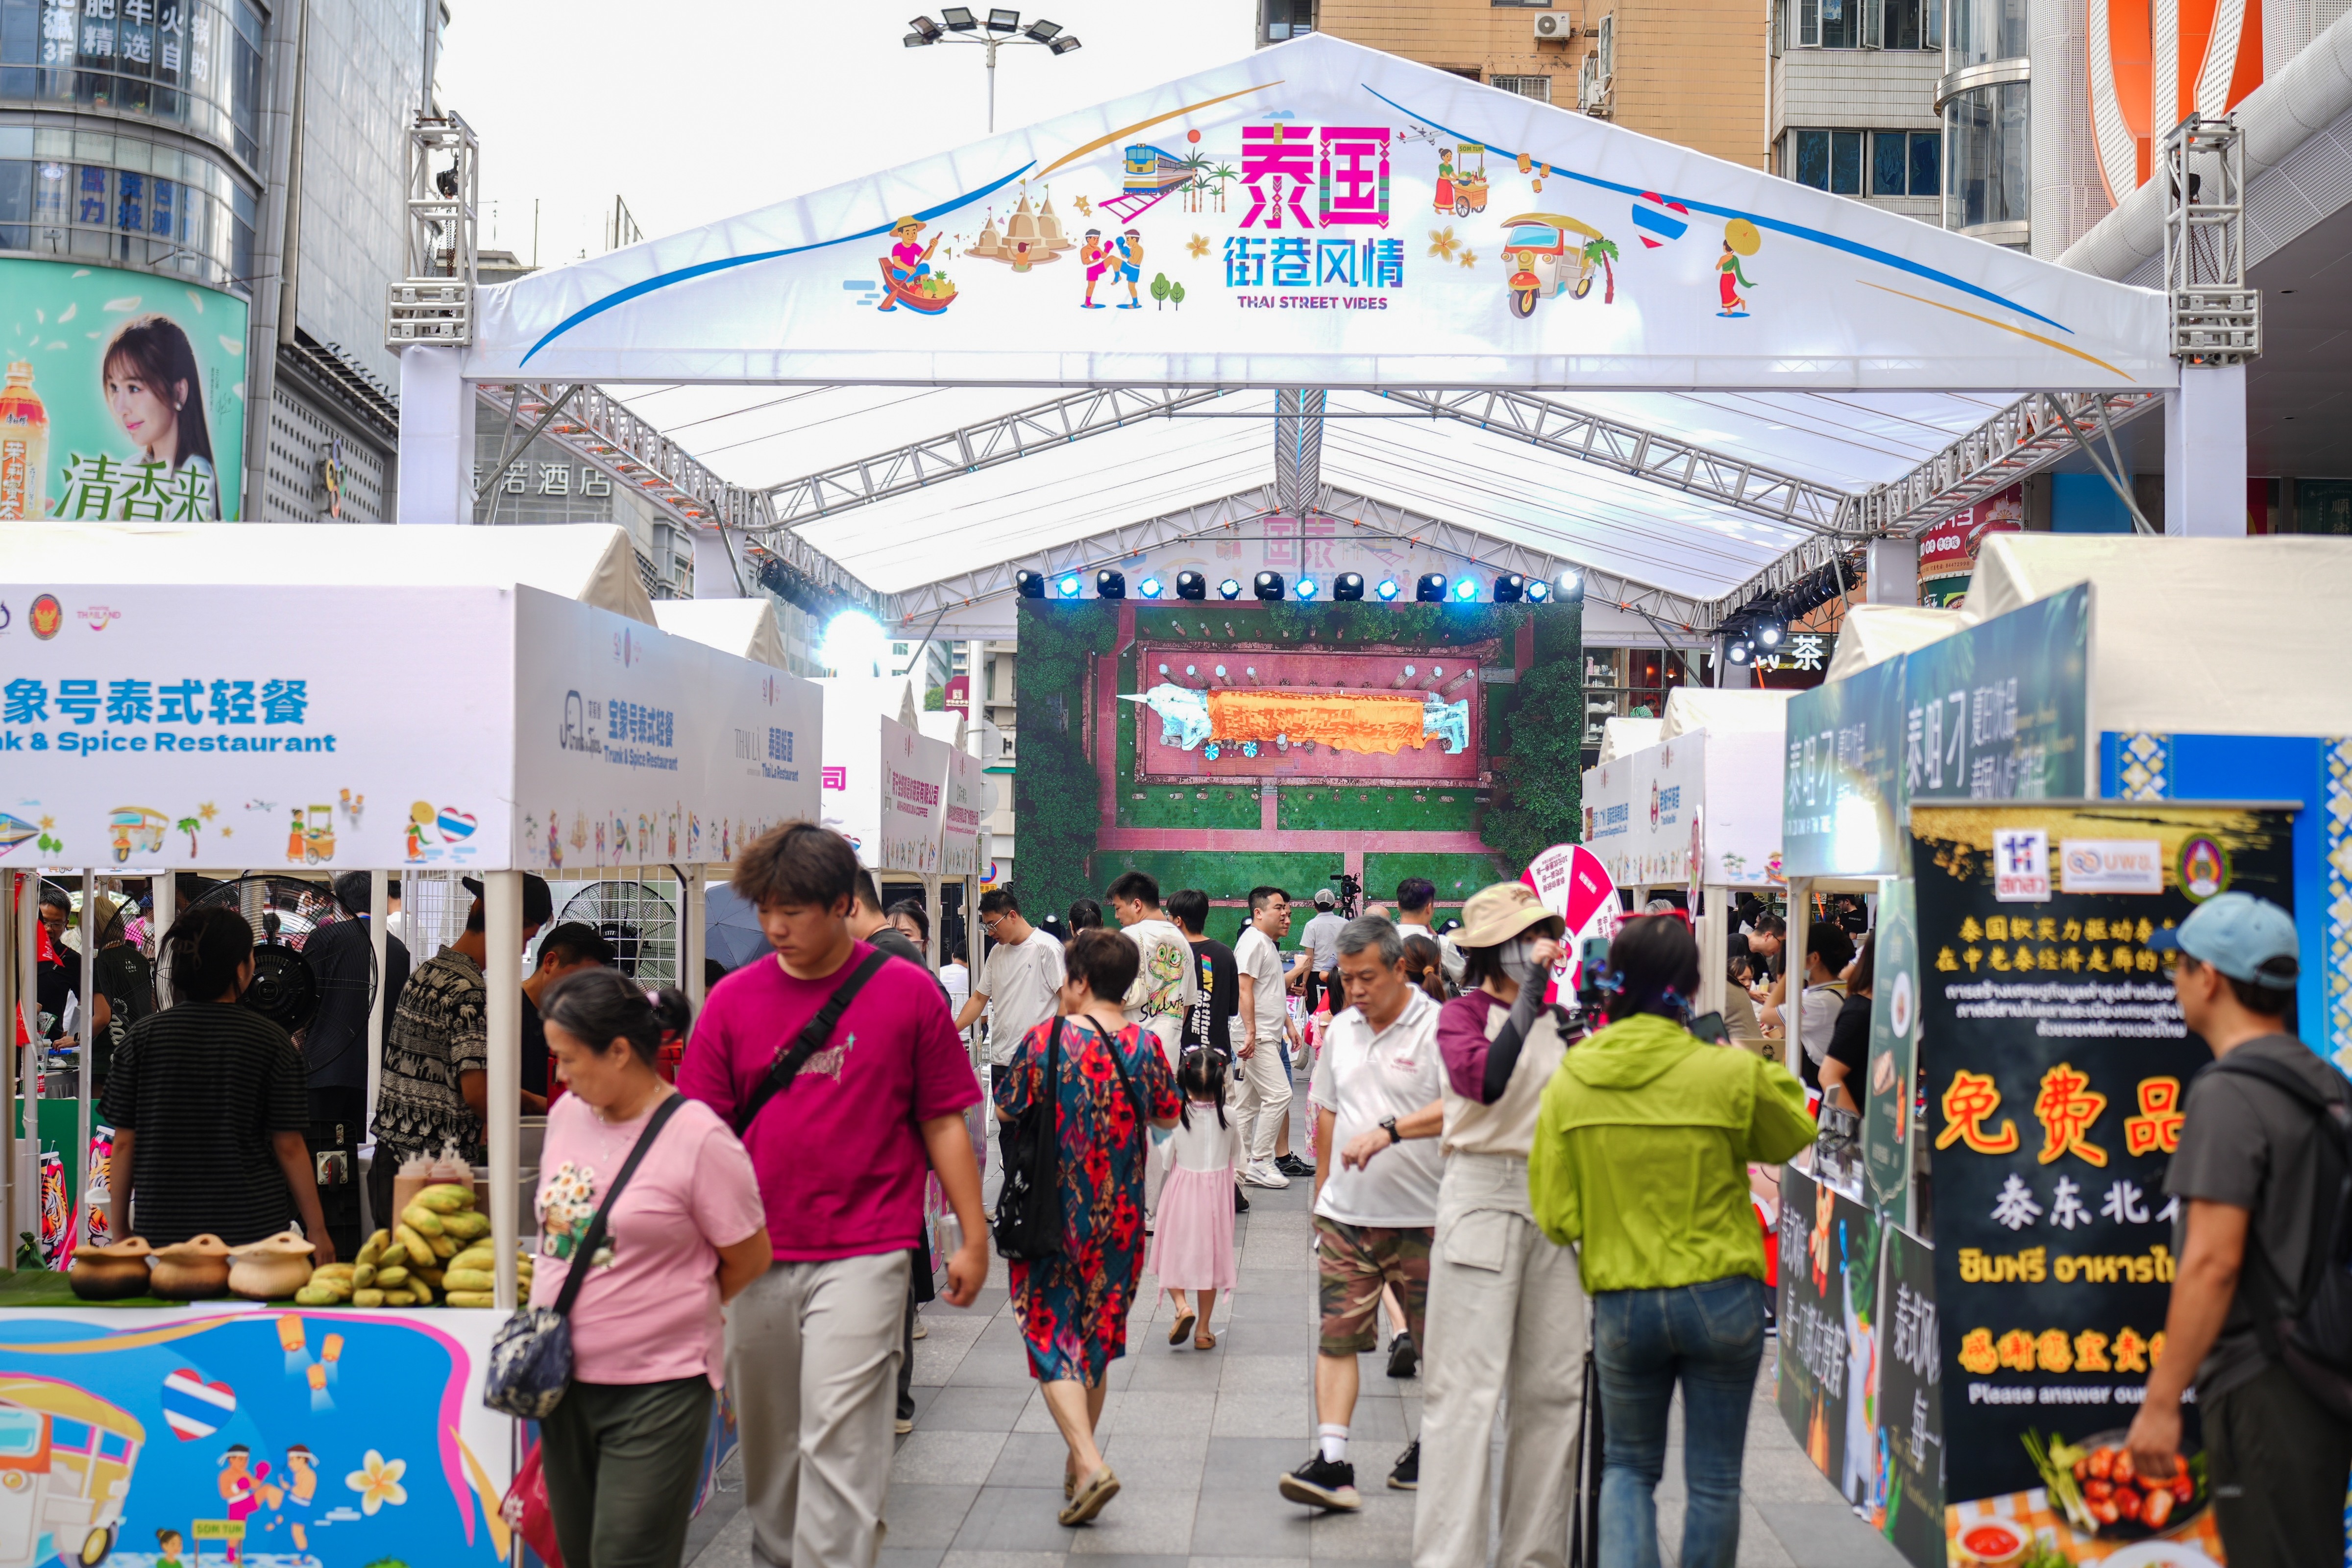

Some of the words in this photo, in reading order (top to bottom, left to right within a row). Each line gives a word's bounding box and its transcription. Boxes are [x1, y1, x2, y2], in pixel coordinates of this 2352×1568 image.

[44, 43, 73, 62] 3F
[1238, 122, 1391, 230] 泰国
[1223, 236, 1404, 288] 街巷风情
[1237, 296, 1274, 309] THAI
[1279, 296, 1339, 309] STREET
[1343, 297, 1388, 310] VIBES
[2, 678, 309, 726] 象号泰式轻餐
[31, 733, 49, 751] &
[57, 730, 147, 757] Spice
[154, 732, 336, 753] Restaurant
[647, 751, 678, 771] Restaurant
[777, 765, 798, 782] Restaurant
[916, 806, 928, 818] COFFEE
[1202, 969, 1214, 993] MY
[1968, 1382, 2036, 1404] Please
[2038, 1385, 2111, 1404] answer
